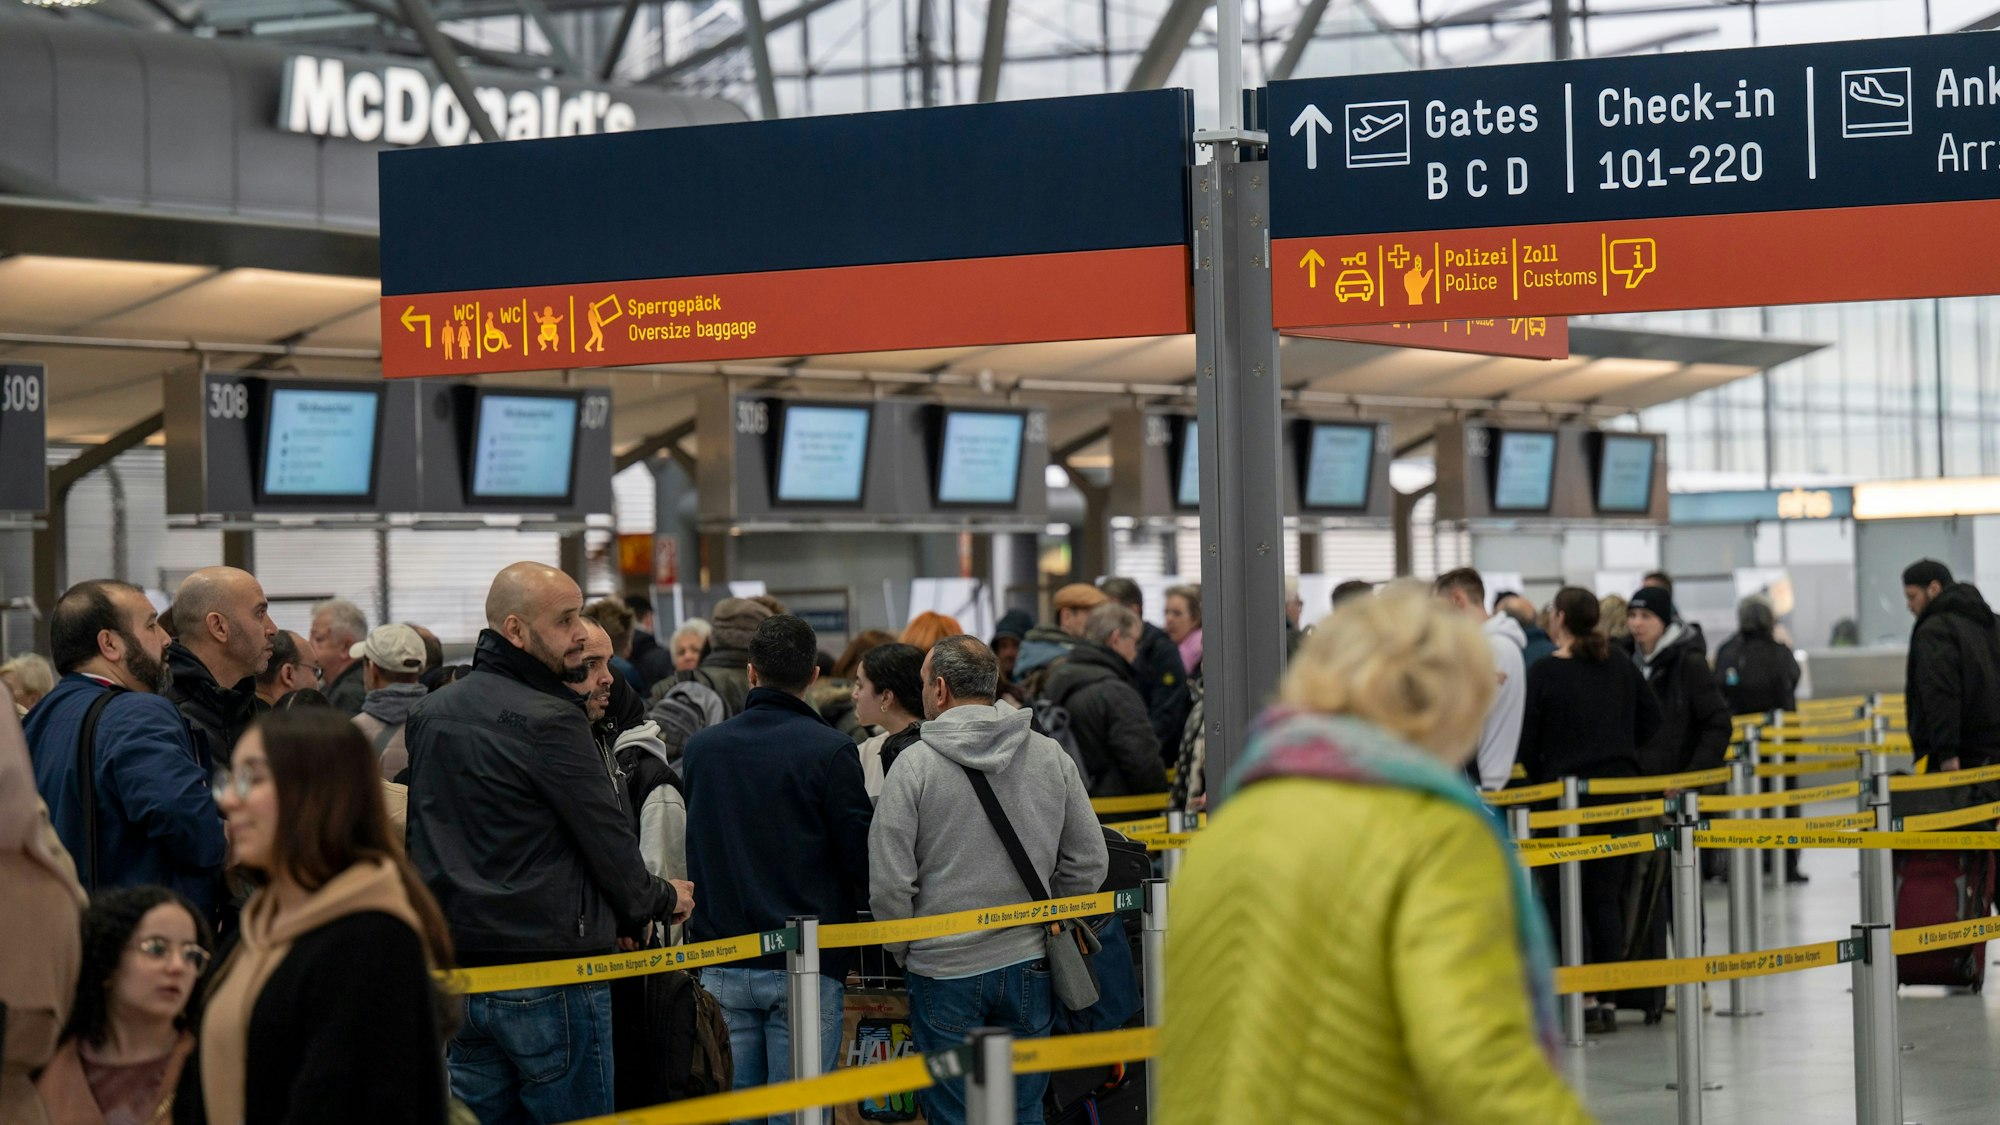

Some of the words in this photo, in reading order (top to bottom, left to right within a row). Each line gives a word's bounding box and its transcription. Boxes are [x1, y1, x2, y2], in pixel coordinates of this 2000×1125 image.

[1598, 79, 1775, 128] Check-in
[1425, 99, 1539, 139] Gates
[1938, 132, 2000, 173] Arr
[1598, 142, 1763, 190] 101-220
[1427, 161, 1449, 200] B
[1466, 159, 1488, 198] C
[1507, 156, 1529, 196] D
[1445, 247, 1508, 267] Polizei
[1523, 244, 1558, 264] Zoll
[1446, 273, 1497, 292] Police
[1523, 269, 1597, 288] Customs
[453, 303, 475, 321] WC
[500, 306, 521, 324] WC
[627, 294, 721, 318] Sperrgepäck
[629, 322, 691, 342] Oversize
[696, 320, 757, 341] baggage
[208, 383, 249, 420] 308
[1729, 836, 1753, 845] Airport
[1801, 836, 1816, 844] Köln
[1819, 836, 1834, 844] Bonn
[1837, 836, 1863, 845] Airport
[1014, 910, 1030, 920] Airport
[1081, 900, 1096, 911] Airport
[686, 950, 699, 960] Köln
[700, 949, 714, 959] Bonn
[716, 945, 737, 957] Airport
[594, 962, 608, 973] Köln
[609, 961, 624, 971] Bonn
[625, 957, 647, 970] Airport
